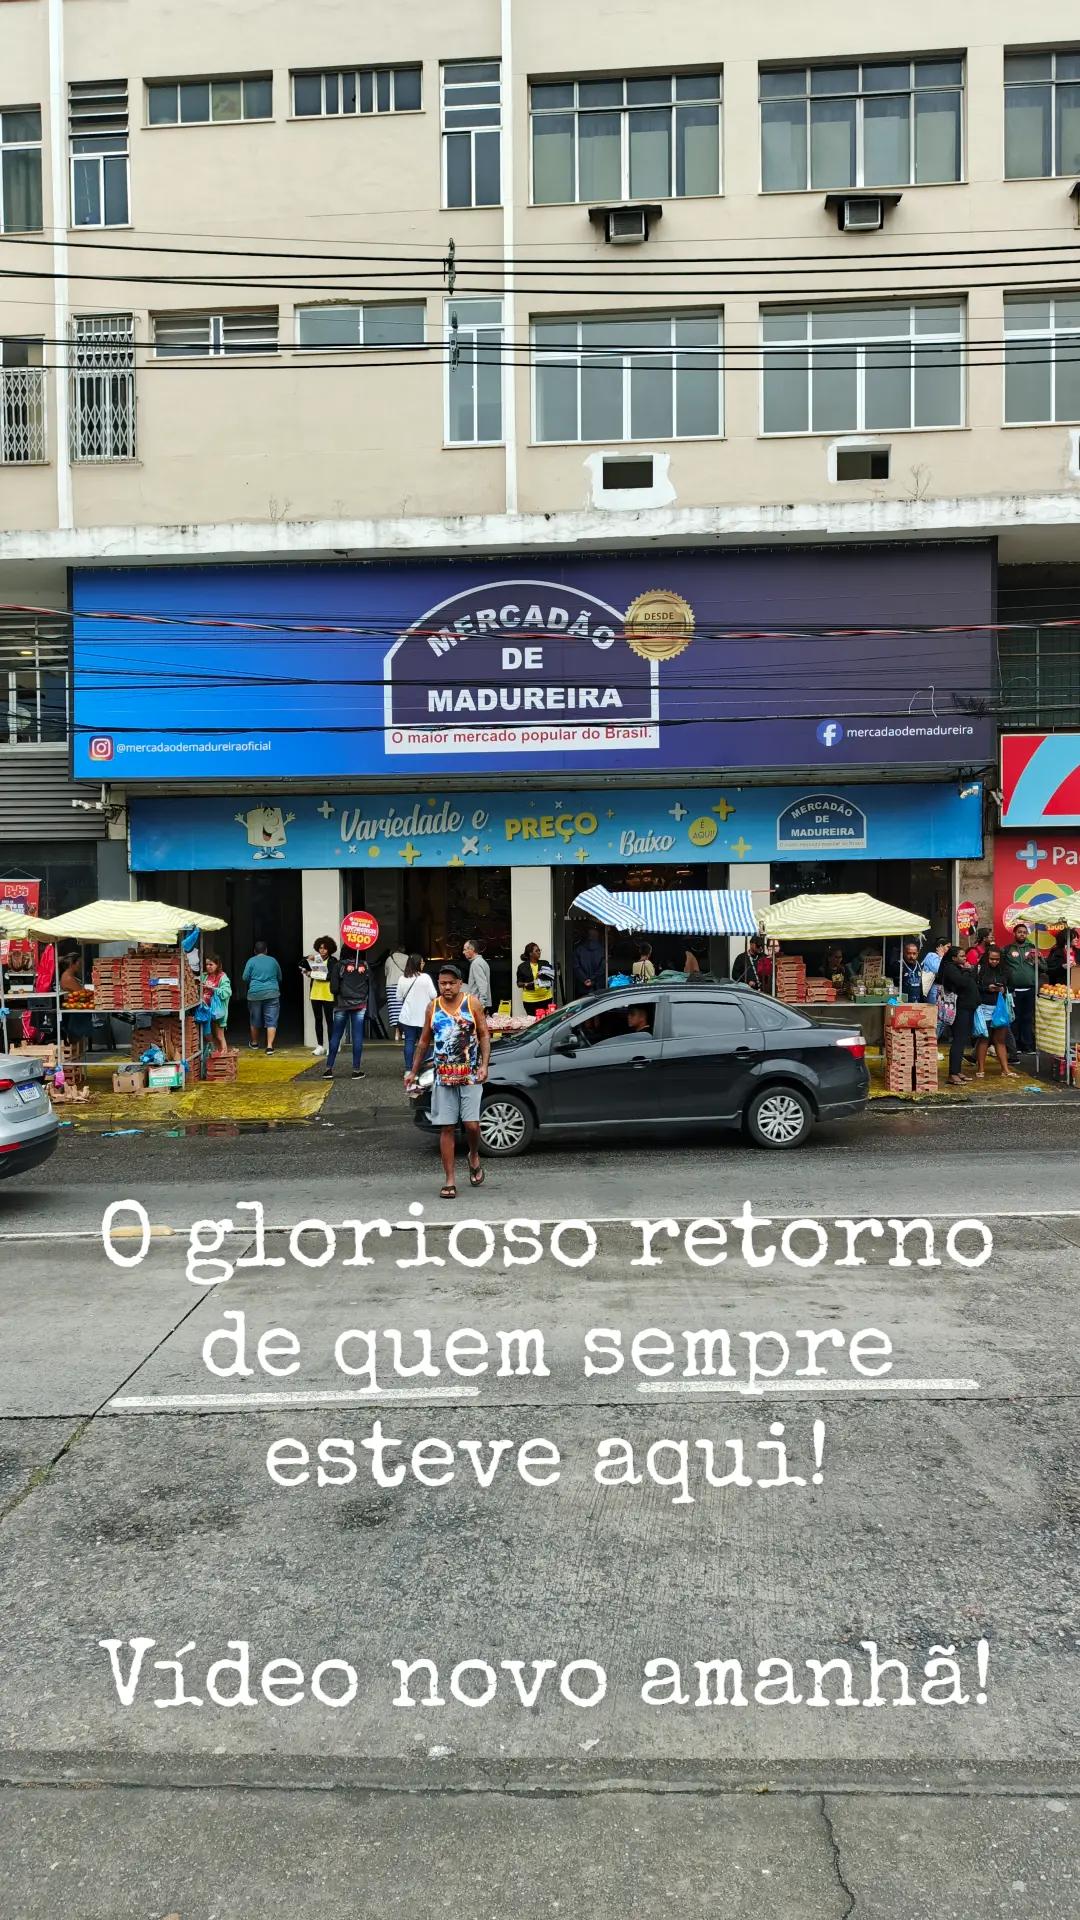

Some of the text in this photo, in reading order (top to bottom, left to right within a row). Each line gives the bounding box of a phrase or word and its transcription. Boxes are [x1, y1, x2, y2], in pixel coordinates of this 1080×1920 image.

[644, 612, 675, 621] DESDE
[426, 604, 616, 657] MERCADÃO
[502, 647, 544, 670] DE
[427, 687, 623, 713] MADUREIRA
[392, 726, 652, 744] O maior mercado popular do Brasil.
[846, 725, 974, 737] mercadaodemadureira
[116, 741, 272, 753] @mercadaodemadureiraoficial
[791, 801, 853, 819] MERCADÃO
[340, 801, 489, 842] Variedade e
[504, 811, 598, 844] PREÇO
[815, 815, 830, 824] DE
[791, 827, 855, 837] MADUREIRA
[619, 829, 676, 857] Baixo
[1052, 846, 1080, 865] Pa
[346, 933, 372, 945] 1300
